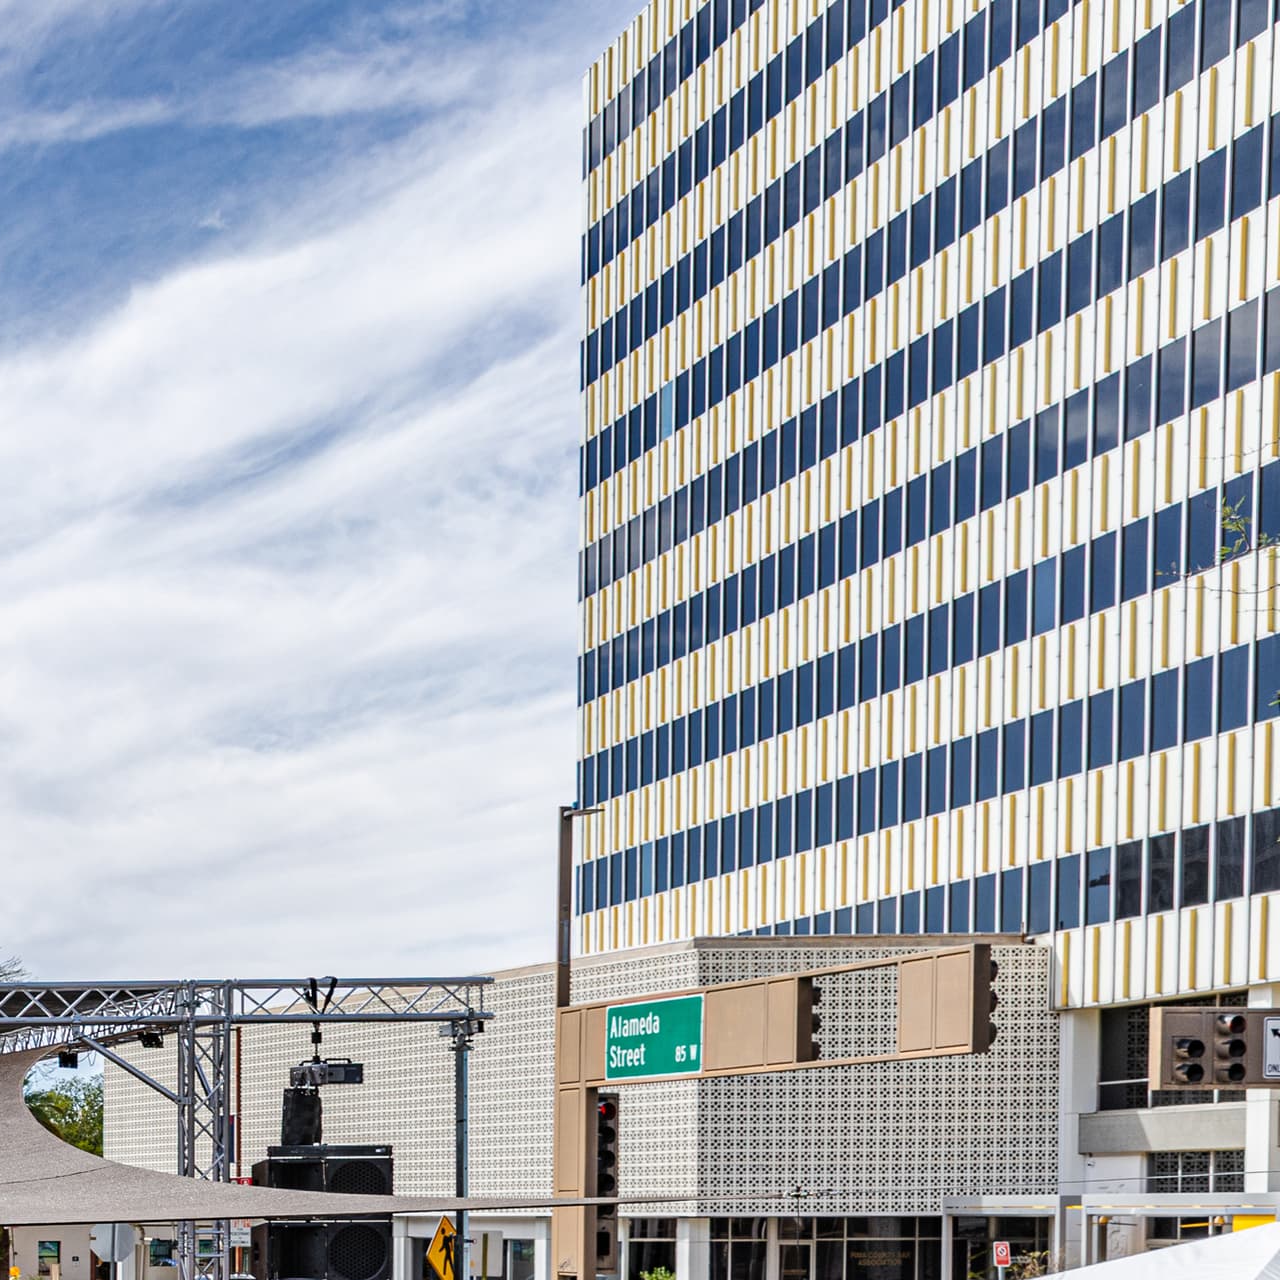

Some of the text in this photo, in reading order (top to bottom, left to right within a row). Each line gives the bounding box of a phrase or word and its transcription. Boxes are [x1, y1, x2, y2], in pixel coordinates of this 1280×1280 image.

[609, 1011, 660, 1039] Alameda
[609, 1043, 698, 1068] Street 85 W
[1268, 1063, 1280, 1074] ONL
